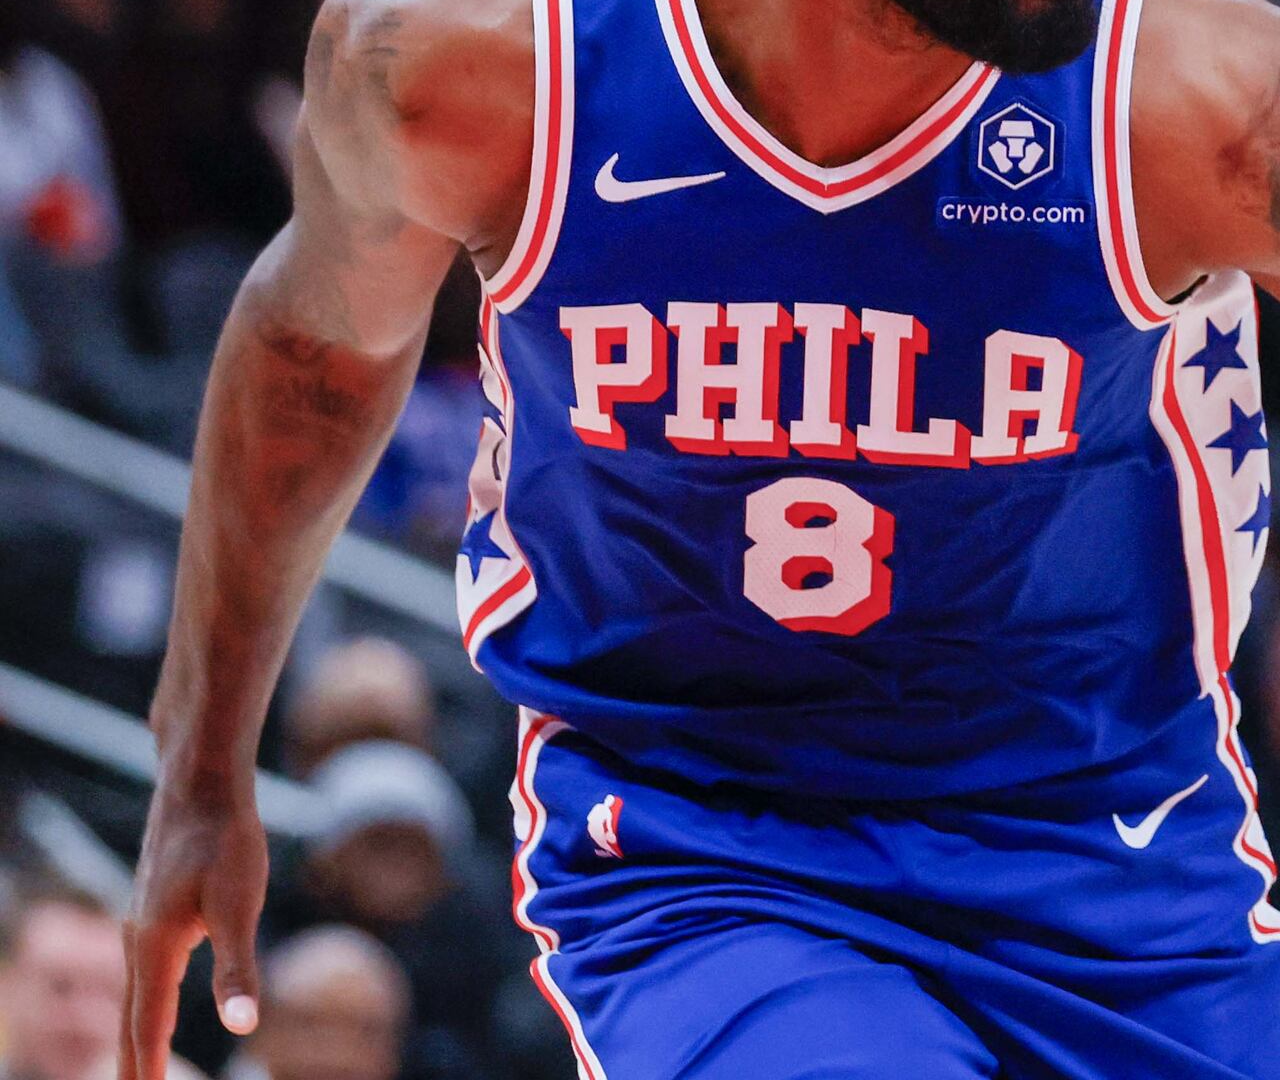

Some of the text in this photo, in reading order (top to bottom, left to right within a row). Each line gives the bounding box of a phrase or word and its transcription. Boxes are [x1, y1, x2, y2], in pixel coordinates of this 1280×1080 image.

[941, 201, 1085, 225] crypto.com
[558, 300, 1084, 470] PHILA
[742, 477, 895, 636] 8
